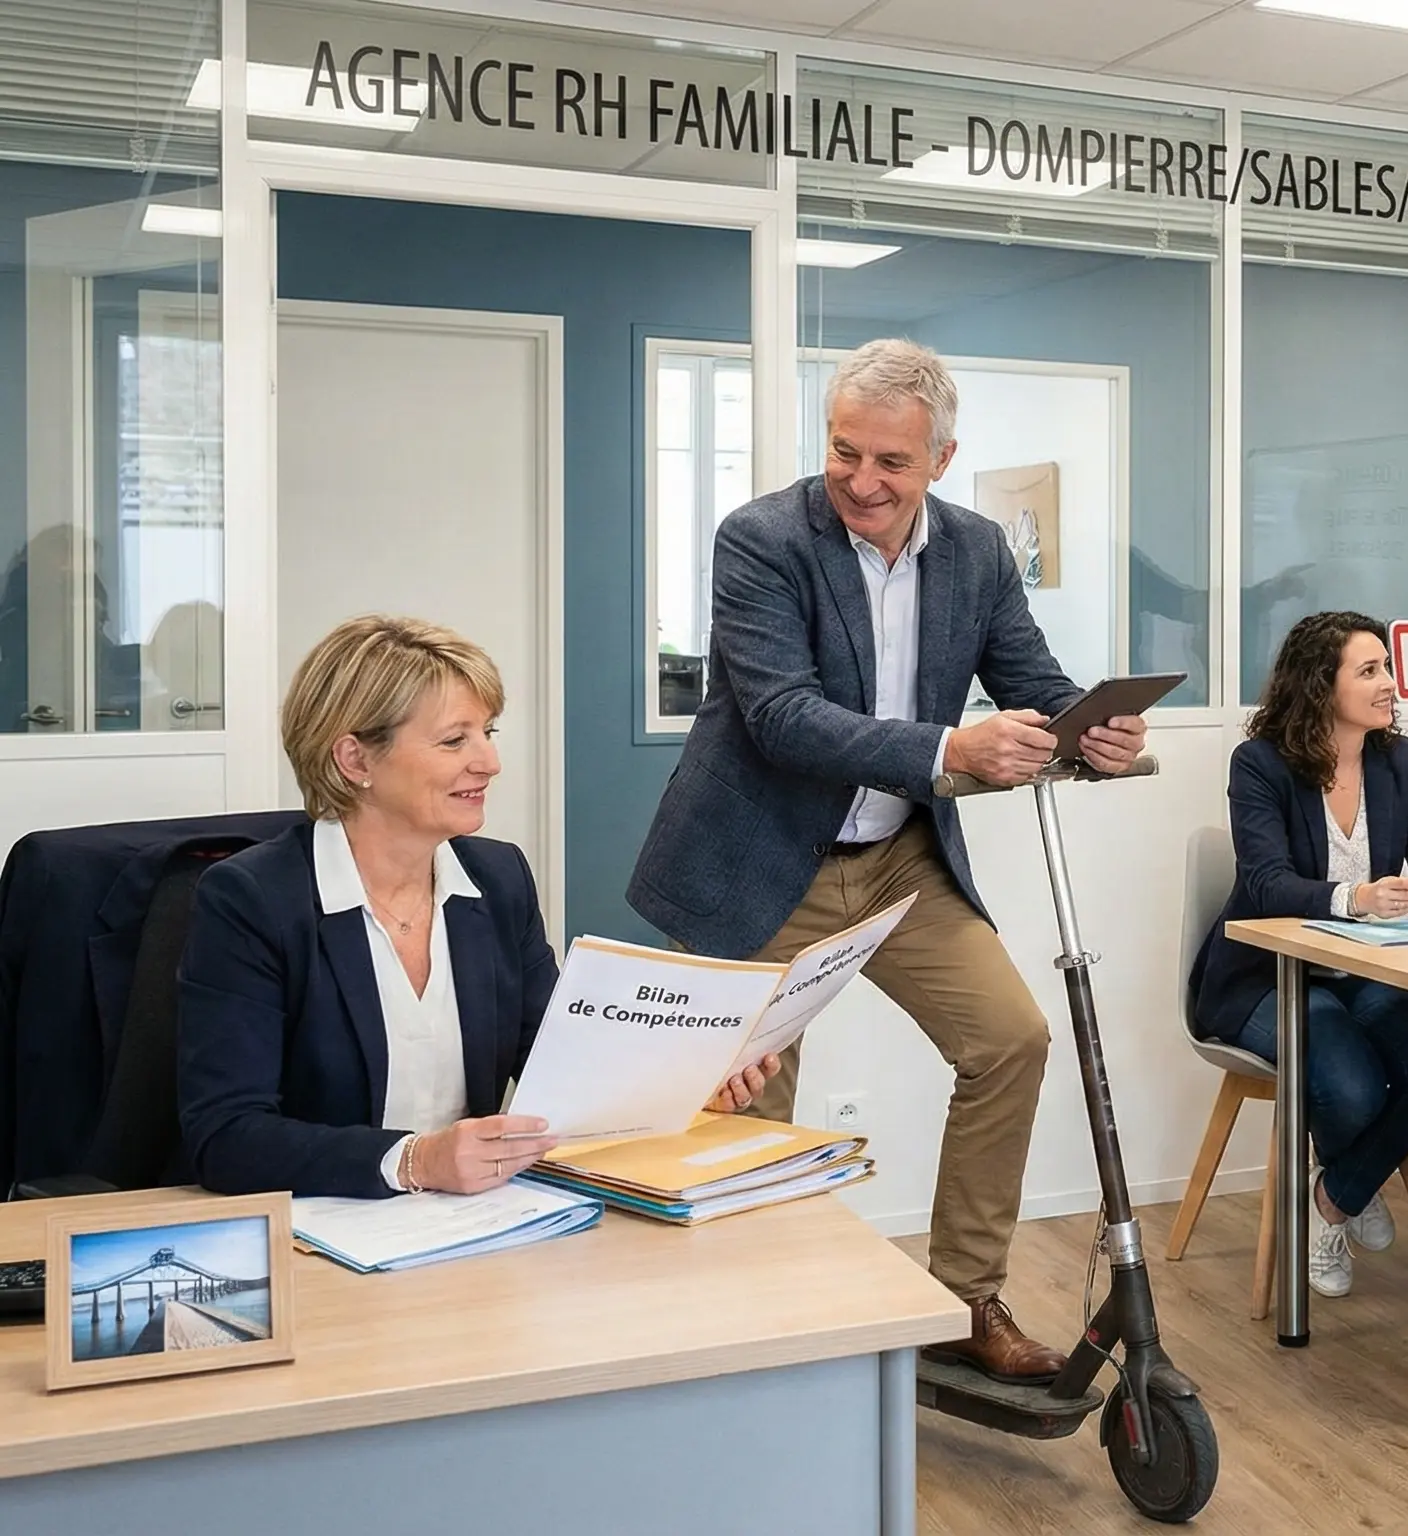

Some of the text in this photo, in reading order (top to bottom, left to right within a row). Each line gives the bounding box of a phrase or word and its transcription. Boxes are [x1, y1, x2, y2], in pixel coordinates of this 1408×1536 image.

[304, 40, 536, 130] AGENCE
[554, 67, 627, 139] RH
[649, 80, 914, 169] FAMILIALE
[635, 984, 690, 1006] Bilan
[567, 999, 743, 1029] de Compétences
